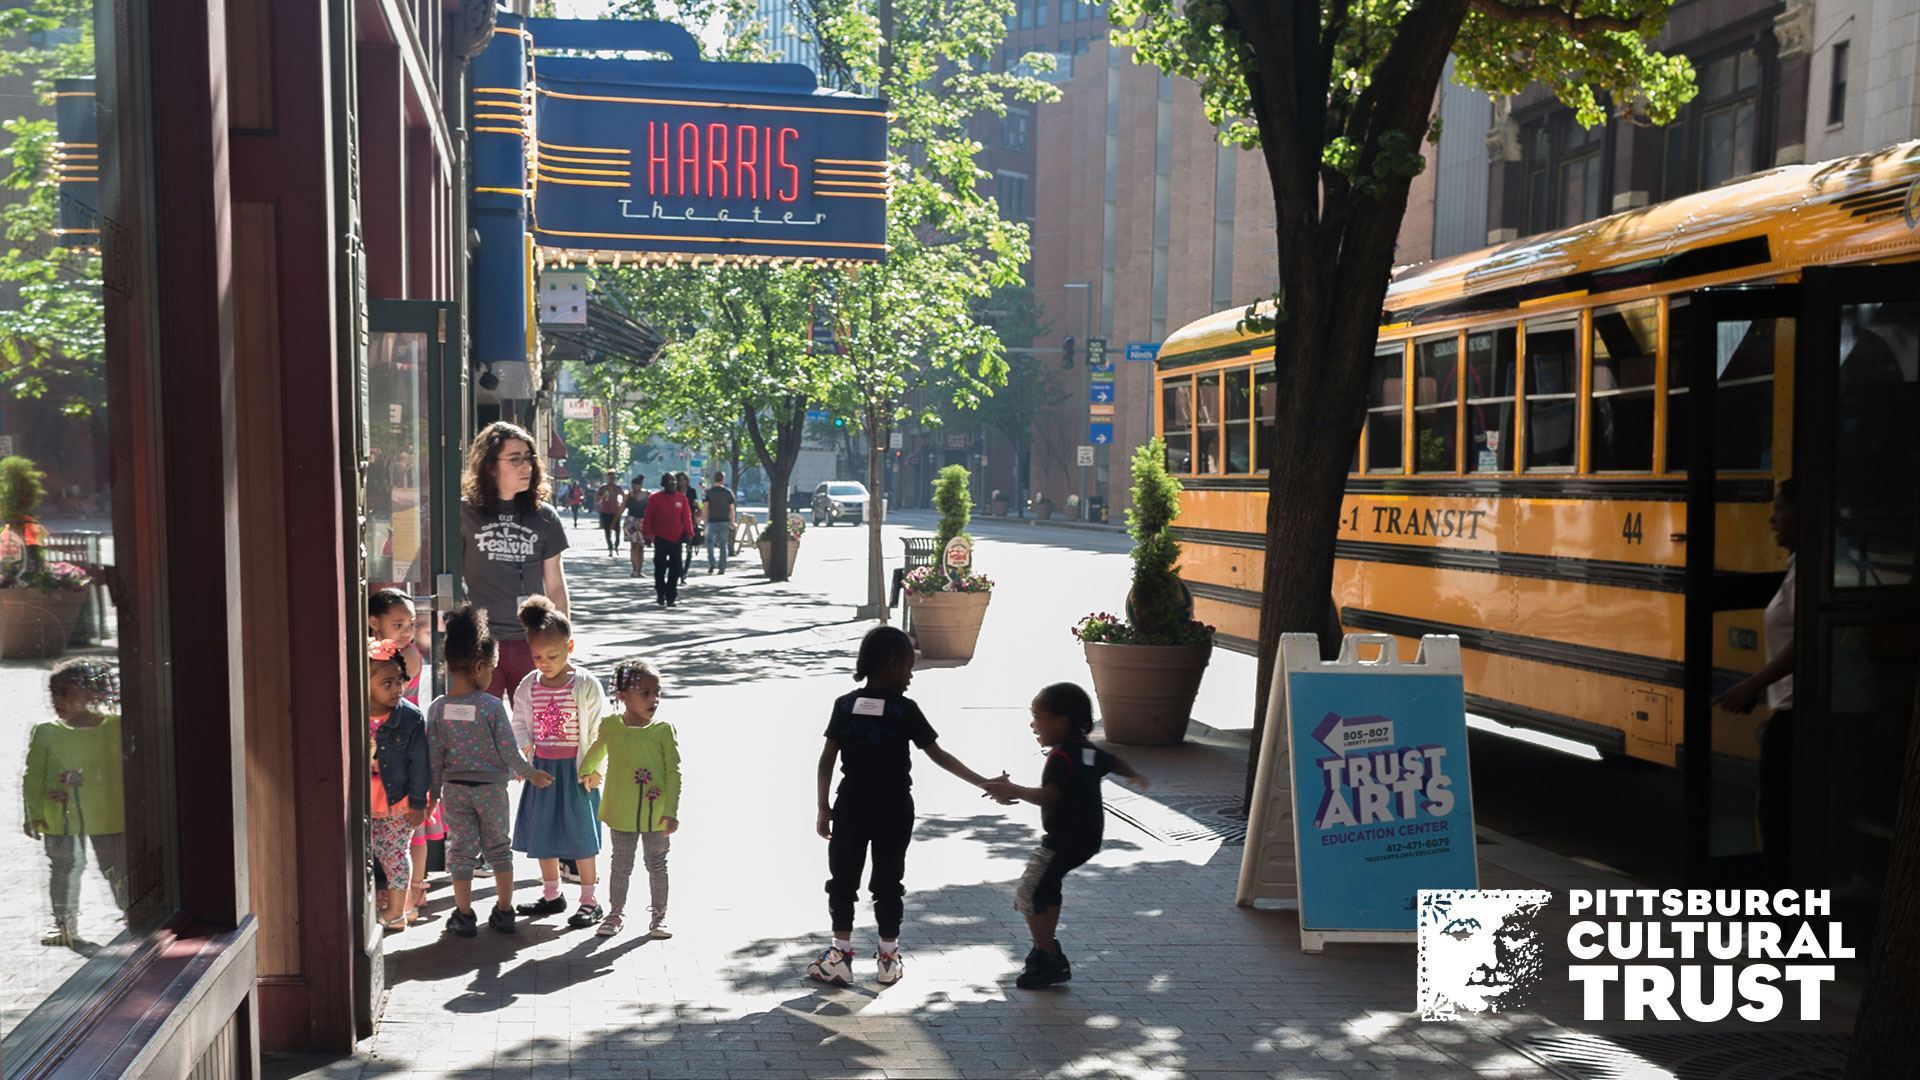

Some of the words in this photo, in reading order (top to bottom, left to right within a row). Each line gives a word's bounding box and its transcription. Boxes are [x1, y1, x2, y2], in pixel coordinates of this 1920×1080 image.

[647, 121, 800, 203] HARRIS
[618, 199, 827, 226] Theater
[1130, 351, 1153, 359] Ninth
[1079, 456, 1092, 464] 25
[1337, 506, 1359, 532] -1
[1372, 506, 1486, 540] TRANSIT
[1622, 512, 1643, 545] 44
[474, 527, 539, 555] Festival
[1343, 727, 1389, 741] 805-807
[1343, 739, 1367, 747] LIBERTY
[1368, 736, 1389, 744] AVENUE
[1322, 746, 1447, 791] TRUST
[1319, 774, 1454, 830] ARTS
[1321, 827, 1395, 847] EDUCATION
[1398, 820, 1449, 837] CENTER
[1385, 837, 1450, 853] 412-471-6079
